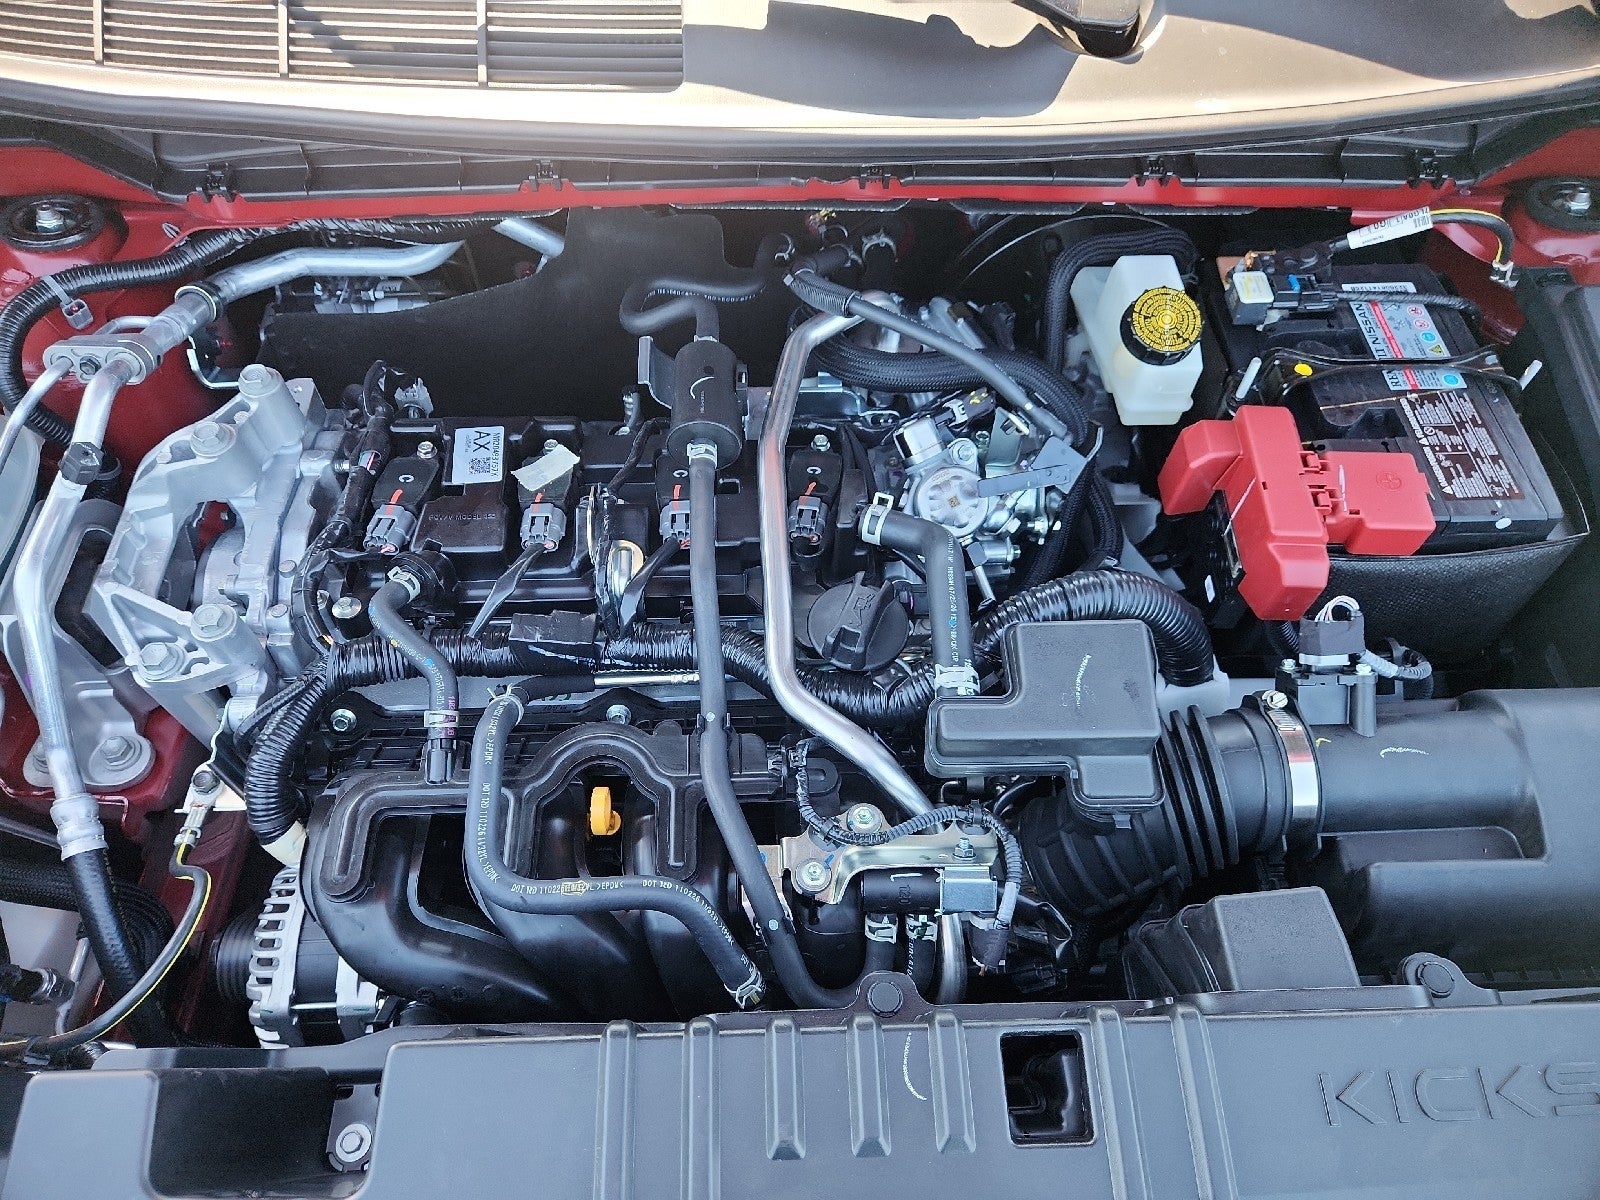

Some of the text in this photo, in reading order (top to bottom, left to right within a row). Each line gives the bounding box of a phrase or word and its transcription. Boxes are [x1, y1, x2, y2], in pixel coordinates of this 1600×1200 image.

[1353, 303, 1381, 345] NISSAN
[472, 430, 491, 452] AX
[1317, 1061, 1600, 1127] KICKS
